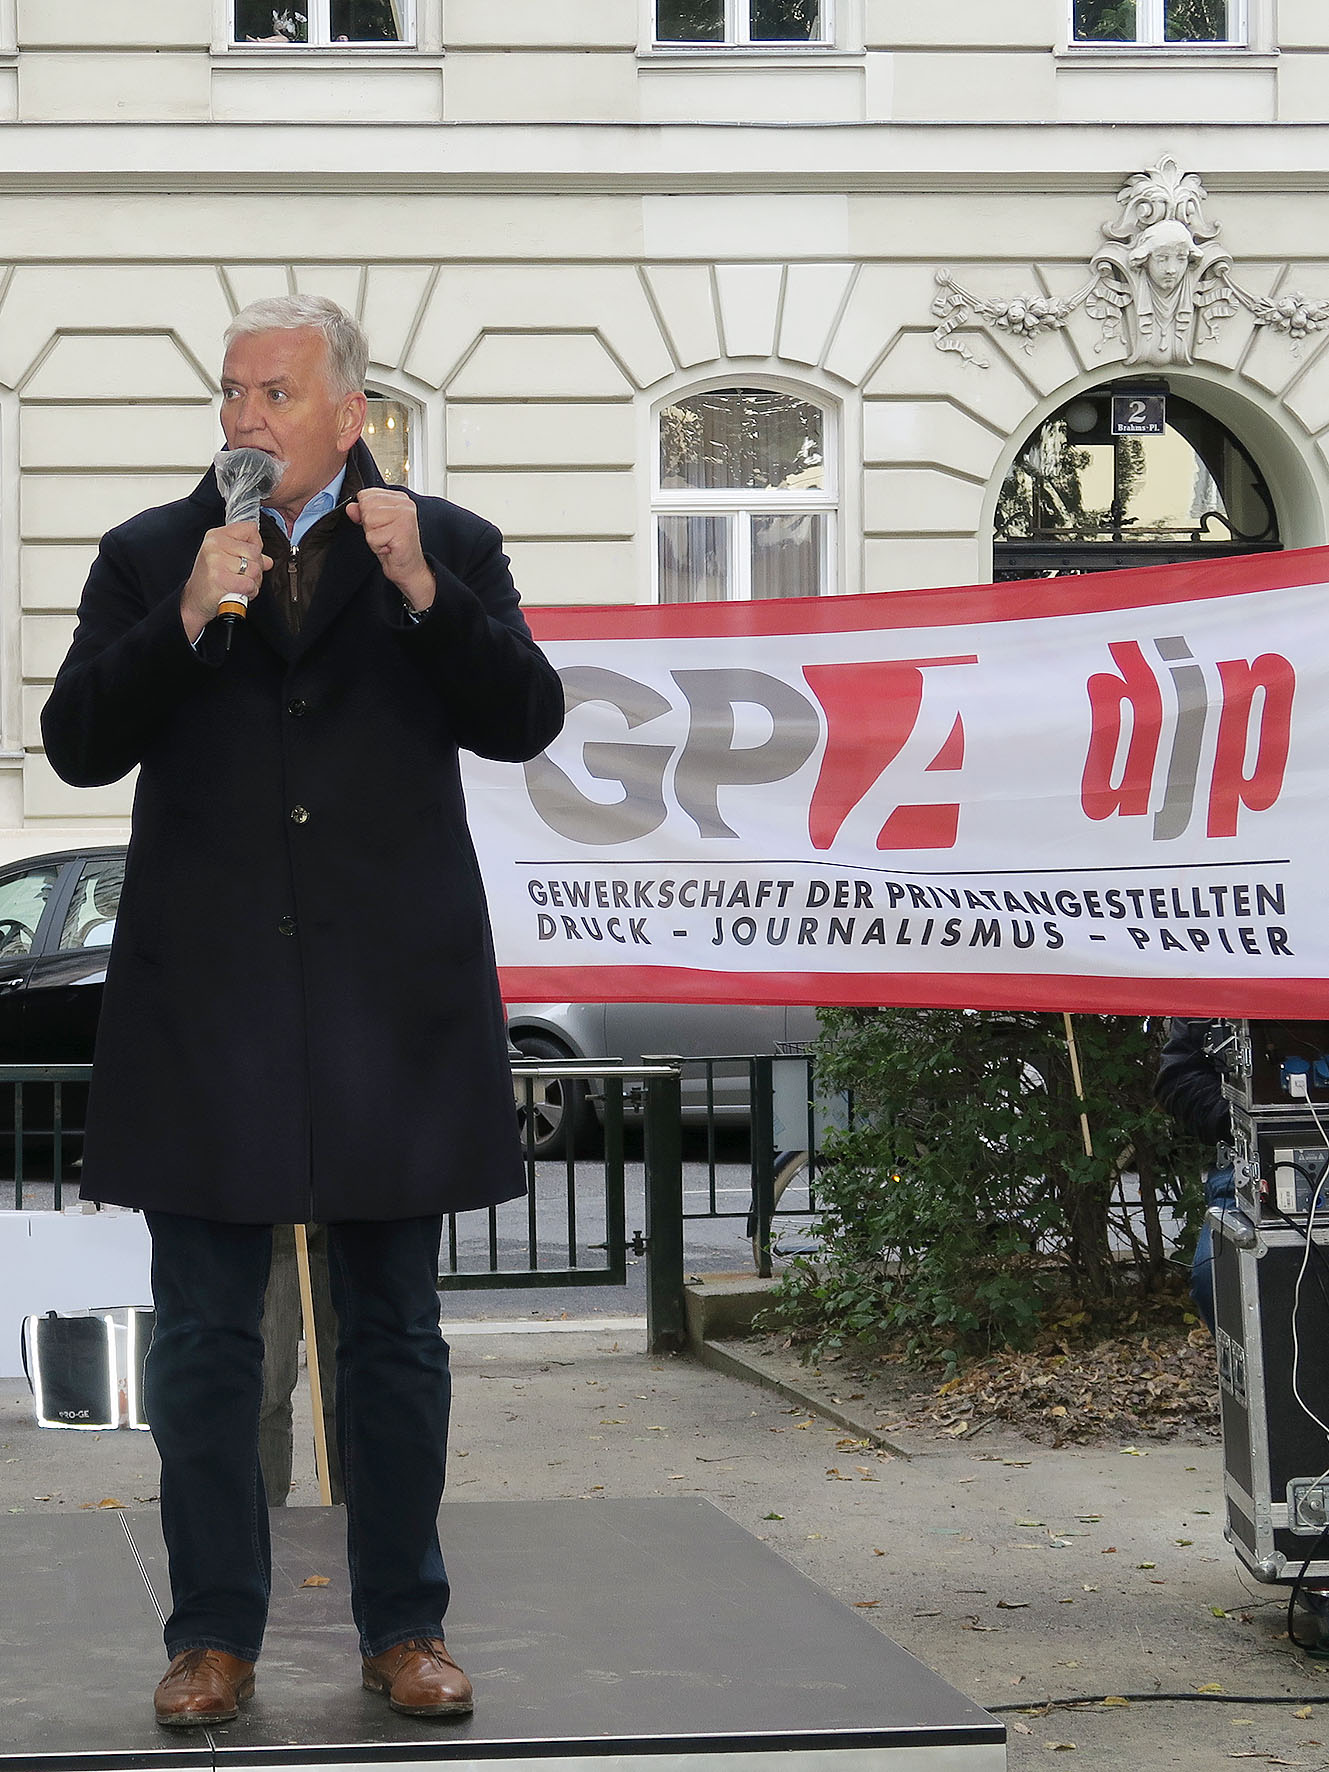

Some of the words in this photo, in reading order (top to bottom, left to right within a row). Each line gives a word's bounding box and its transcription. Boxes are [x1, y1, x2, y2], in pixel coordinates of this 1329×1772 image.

[1128, 400, 1147, 423] 2
[524, 654, 979, 851] GPA
[1080, 635, 1297, 842] djp
[526, 878, 795, 910] GEWERKSCHAFT
[805, 880, 875, 911] DER
[886, 882, 1287, 919] PRIVATANGESTELLTEN
[537, 913, 653, 946] DRUCK
[710, 916, 1065, 949] JOURNALISMUS
[1126, 926, 1295, 957] PAPIER
